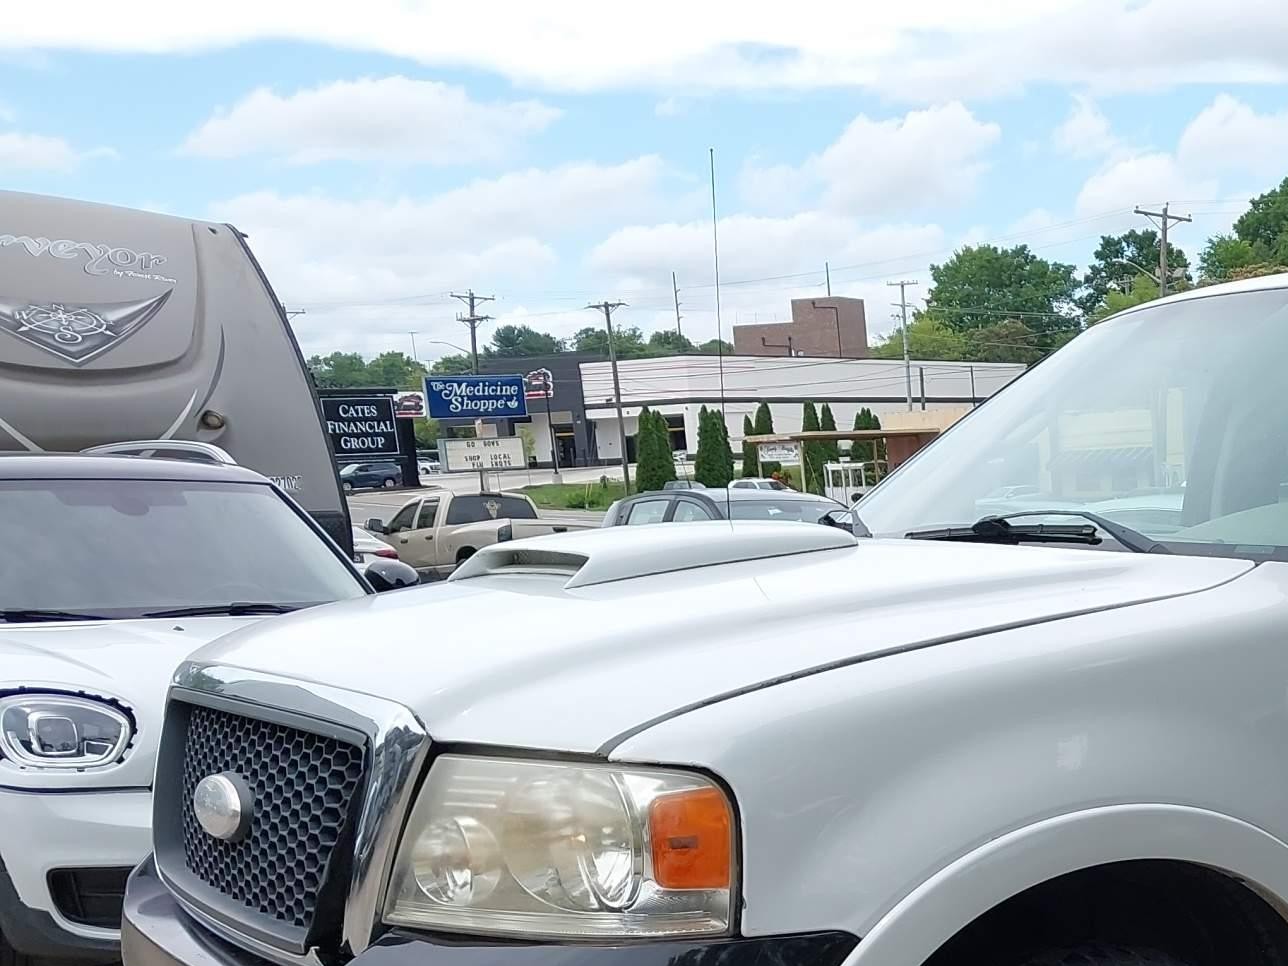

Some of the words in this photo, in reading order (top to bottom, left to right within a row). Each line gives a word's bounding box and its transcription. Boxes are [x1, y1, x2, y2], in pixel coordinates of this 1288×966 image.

[430, 381, 446, 391] The
[442, 382, 518, 399] Medicine
[338, 404, 378, 417] CATES
[449, 396, 505, 412] Shoppe
[326, 420, 394, 434] FINANCIAL
[340, 436, 385, 449] GROUP
[490, 453, 511, 461] LOCAL
